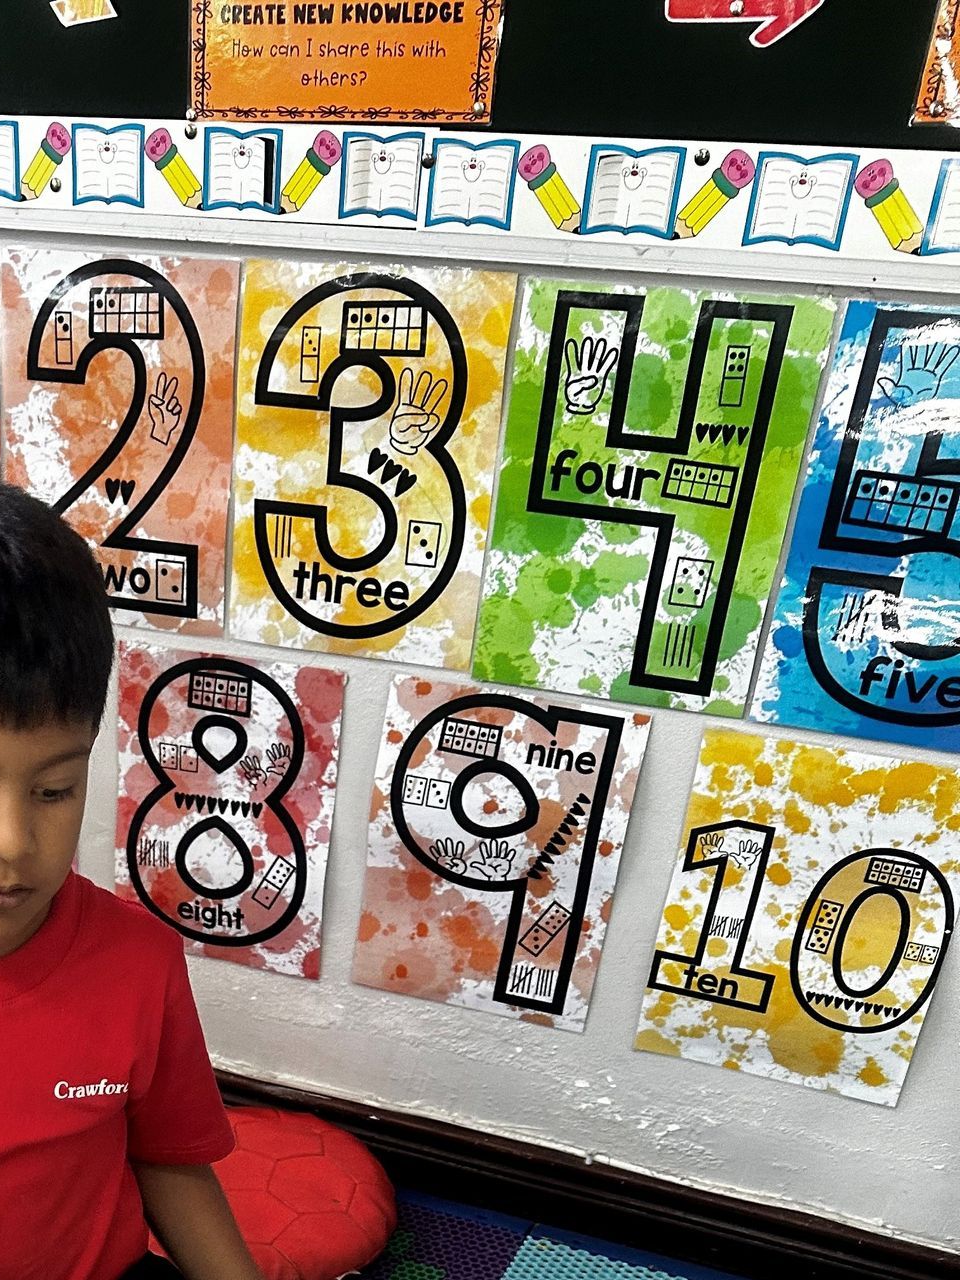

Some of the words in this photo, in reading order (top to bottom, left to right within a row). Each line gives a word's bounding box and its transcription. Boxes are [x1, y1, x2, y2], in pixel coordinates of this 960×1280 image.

[220, 2, 287, 25] CREATE
[293, 2, 334, 25] NEW
[341, 1, 465, 25] KNOWLEDGE
[231, 39, 265, 59] How
[270, 42, 300, 59] can
[305, 38, 313, 58] I
[319, 41, 370, 59] share
[376, 40, 406, 59] this
[412, 39, 447, 59] with
[301, 69, 368, 88] others?
[27, 258, 207, 620] 2
[254, 271, 469, 640] 3
[526, 289, 795, 697] 4
[549, 449, 661, 497] four
[801, 307, 960, 728] 5
[100, 561, 152, 595] wo
[292, 561, 411, 612] three
[858, 656, 960, 709] five
[525, 740, 597, 775] nine
[126, 657, 307, 947] 8
[391, 692, 625, 1016] 9
[178, 900, 245, 930] eight
[647, 819, 955, 1034] 10
[683, 965, 739, 999] ten
